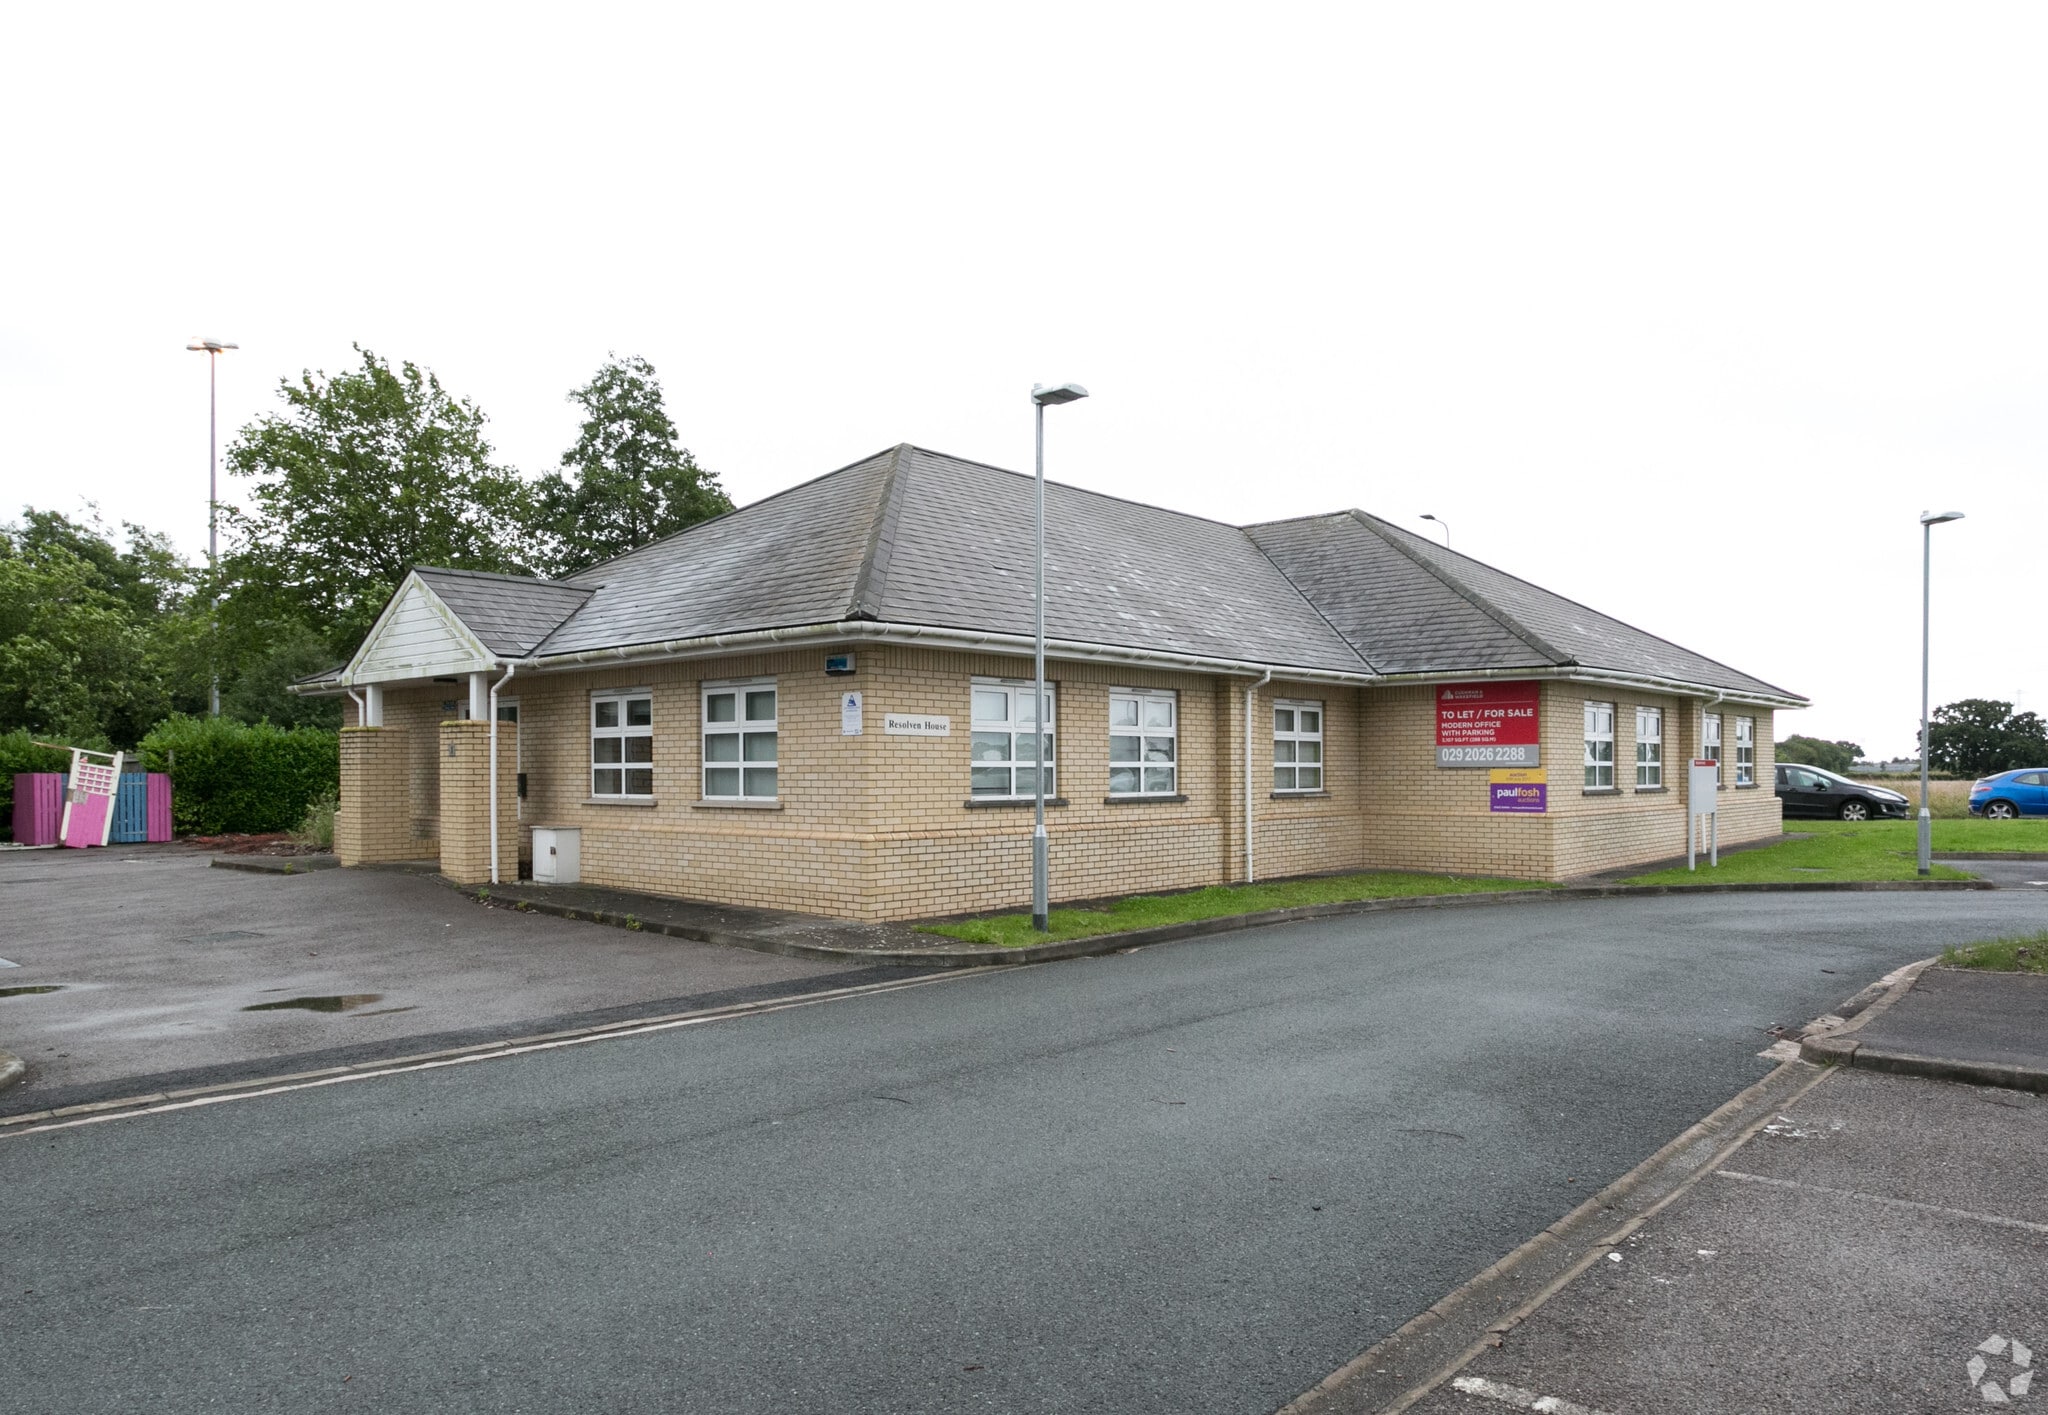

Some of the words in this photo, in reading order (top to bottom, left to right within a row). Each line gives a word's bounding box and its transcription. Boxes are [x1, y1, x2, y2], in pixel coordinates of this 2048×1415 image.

[1441, 711, 1454, 719] TO
[1457, 710, 1474, 719] LET
[1476, 709, 1482, 719] /
[1484, 709, 1504, 718] FOR
[1507, 708, 1533, 717] SALE
[888, 719, 921, 730] Resolven
[924, 721, 947, 731] House
[1441, 721, 1472, 729] MODERN
[1442, 748, 1463, 761] 029
[1464, 747, 1494, 761] 2026
[1495, 747, 1525, 761] 2288
